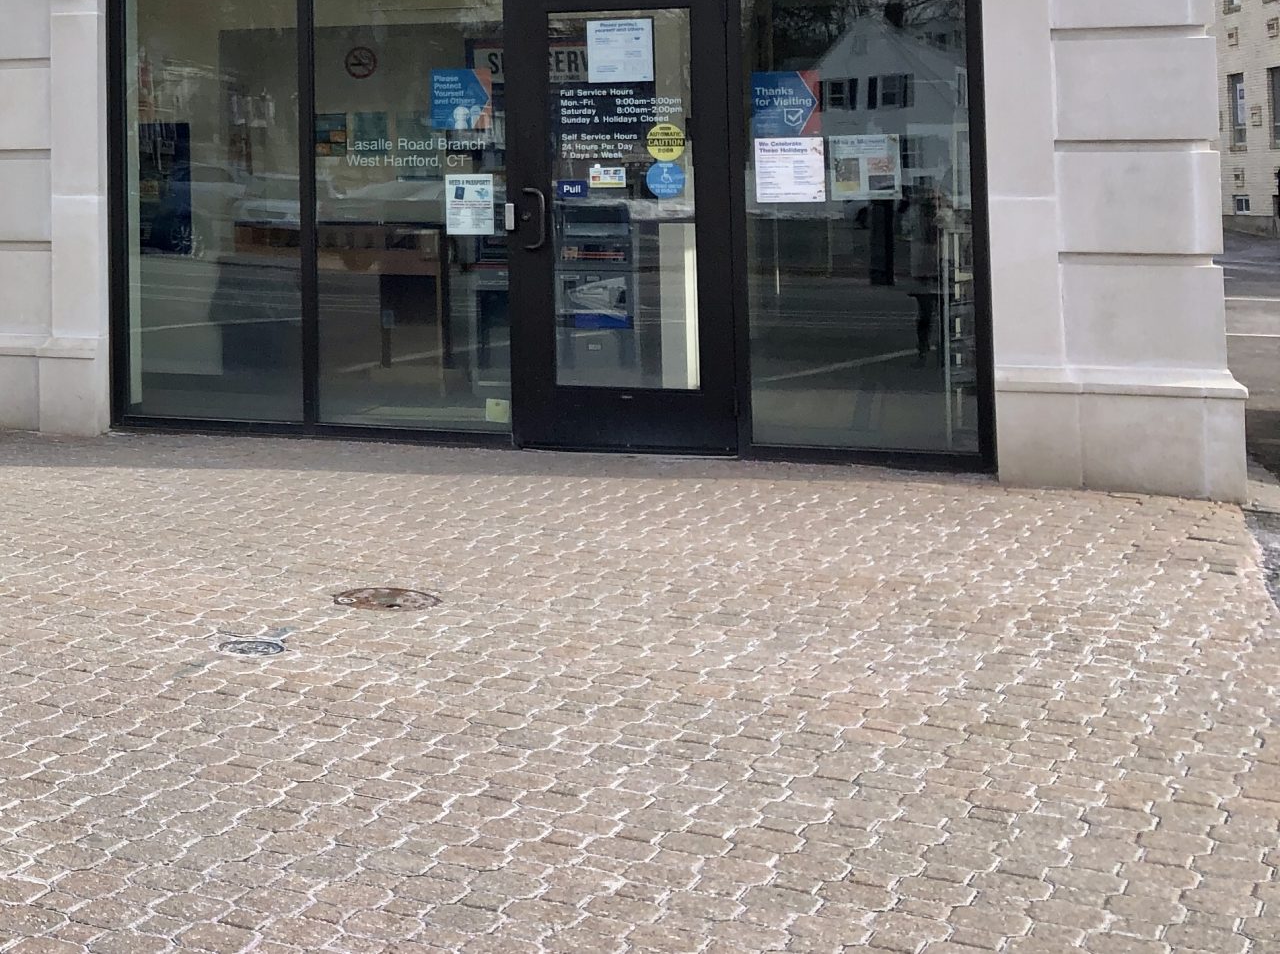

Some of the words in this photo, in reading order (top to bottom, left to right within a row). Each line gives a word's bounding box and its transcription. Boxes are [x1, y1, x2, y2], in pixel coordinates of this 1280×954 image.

[560, 89, 574, 97] Full
[609, 88, 634, 96] Hours
[754, 87, 794, 96] Thanks
[755, 98, 770, 106] for
[773, 96, 813, 107] Visiting
[560, 107, 597, 116] Saturday
[561, 116, 591, 125] Sunday
[603, 115, 638, 123] Holidays
[640, 115, 669, 123] Closed
[561, 133, 577, 141] Self
[346, 138, 392, 151] Lasalle
[397, 138, 433, 151] Road
[438, 138, 486, 151] Branch
[561, 143, 572, 151] 24
[617, 143, 633, 151] Day
[570, 152, 590, 160] Days
[346, 155, 380, 167] West
[384, 154, 442, 168] Hartford,
[446, 155, 467, 167] CT
[563, 185, 581, 193] Pull
